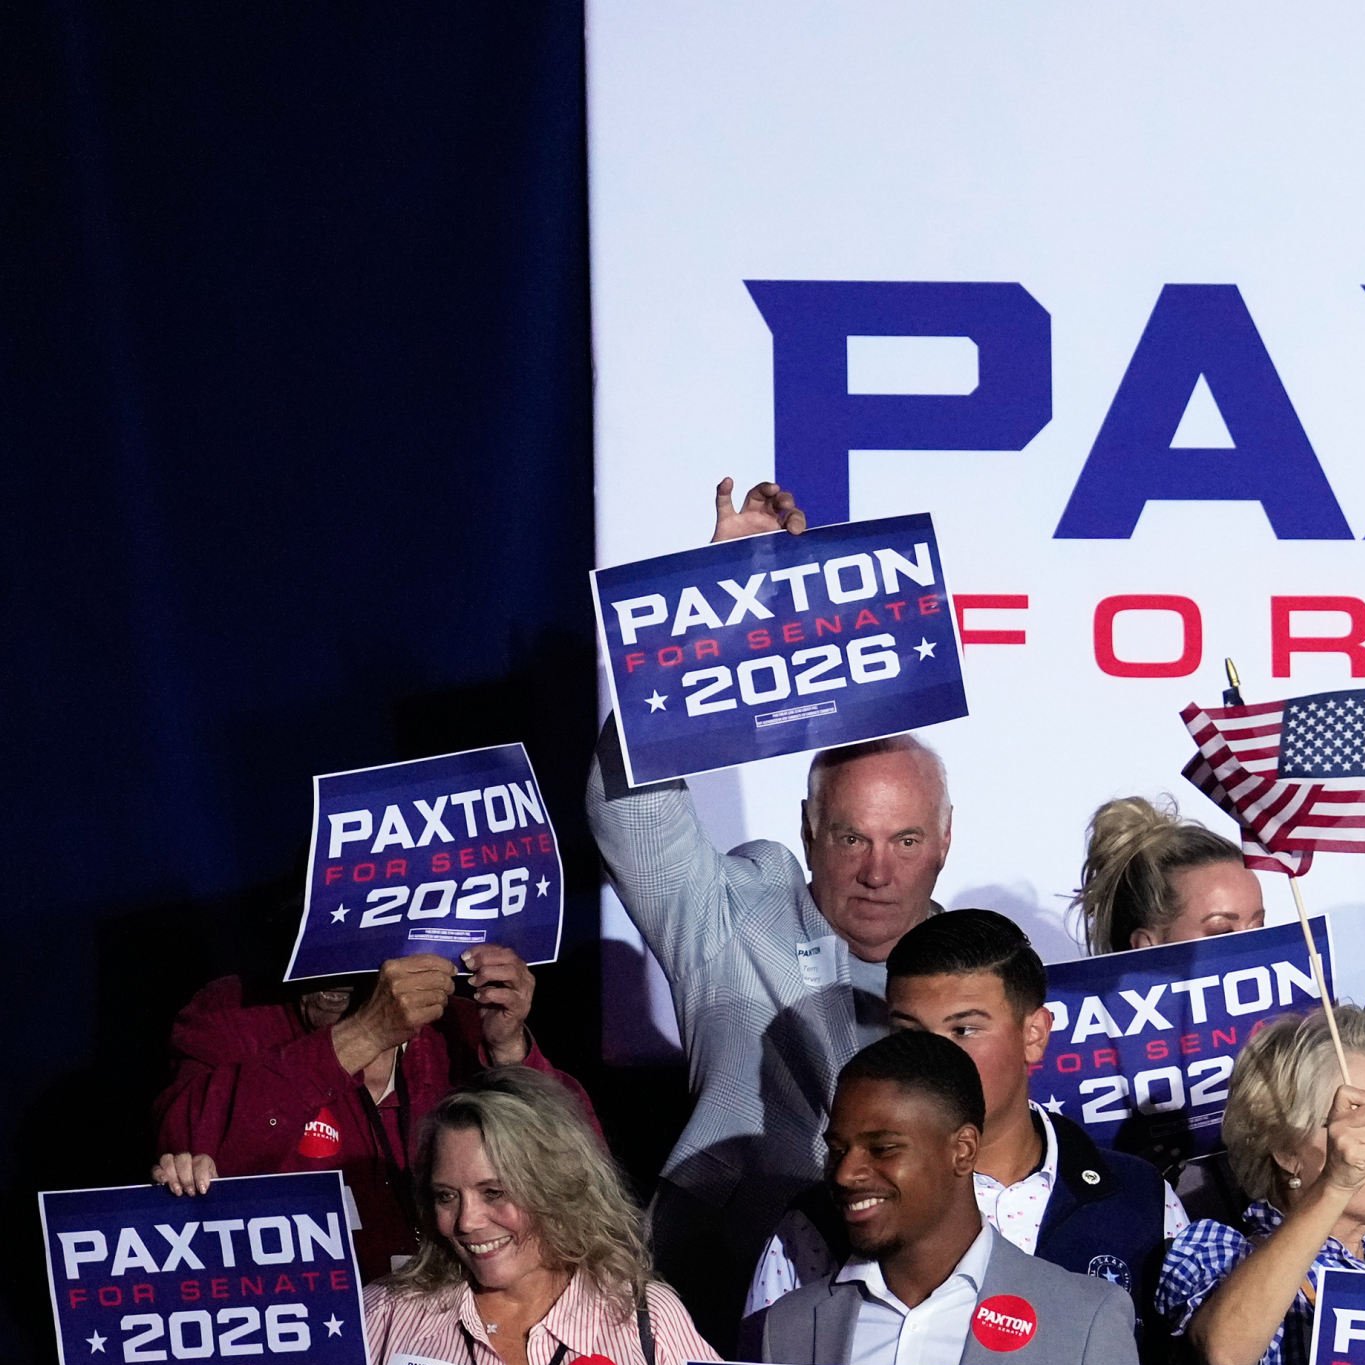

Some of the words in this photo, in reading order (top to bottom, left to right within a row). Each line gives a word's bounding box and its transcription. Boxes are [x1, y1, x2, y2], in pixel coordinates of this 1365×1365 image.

[611, 542, 936, 646] PAXTON
[624, 639, 720, 673] FOR
[746, 594, 942, 650] SENATE
[681, 633, 901, 717] 2026
[327, 780, 545, 859] PAXTON
[324, 859, 407, 886] FOR
[431, 833, 552, 873] SENATE
[359, 867, 529, 928] 2026
[1146, 1020, 1266, 1060] SEN
[1078, 1055, 1234, 1124] 202
[56, 1212, 345, 1280] PAXTON
[69, 1284, 155, 1309] FOR
[181, 1270, 350, 1302] SENATE
[976, 1306, 1033, 1336] PAXTON
[120, 1302, 312, 1363] 2026
